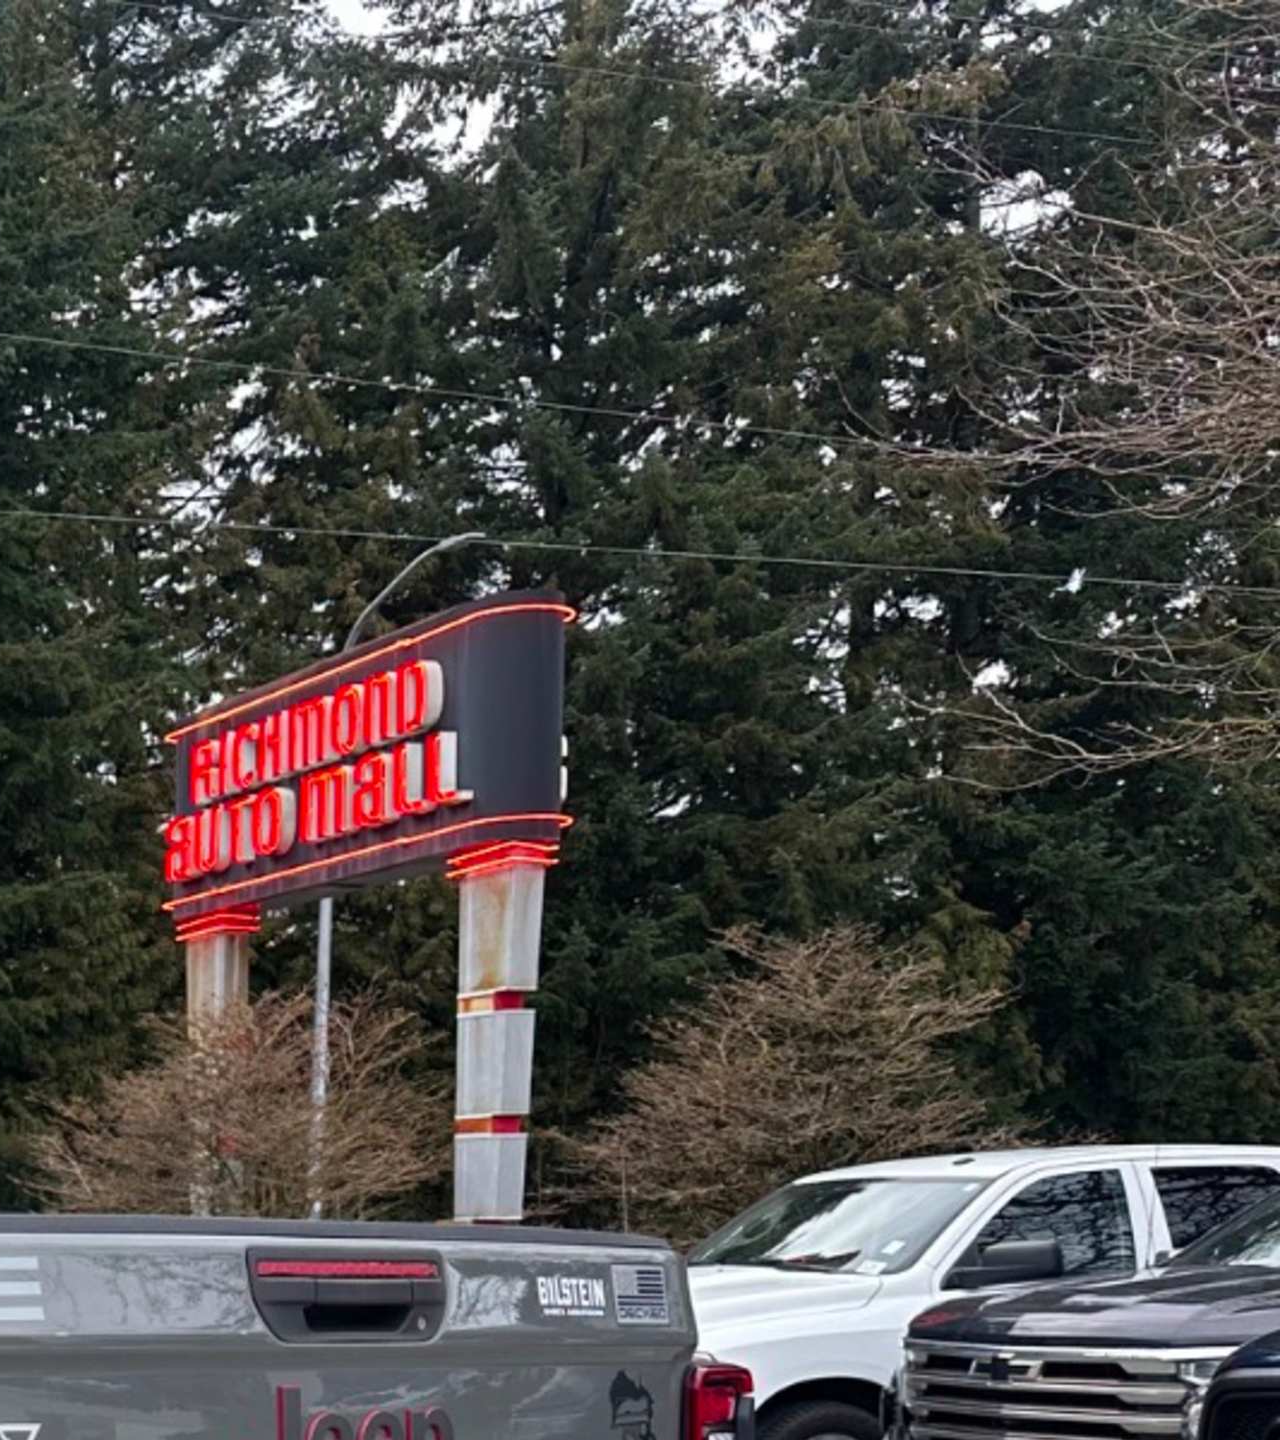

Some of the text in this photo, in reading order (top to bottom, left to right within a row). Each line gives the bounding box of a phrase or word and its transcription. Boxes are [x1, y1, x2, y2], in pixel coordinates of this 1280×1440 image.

[190, 659, 444, 806] RICHMOND
[165, 731, 474, 883] AUTO MALL
[536, 1275, 606, 1307] BILSTEIN
